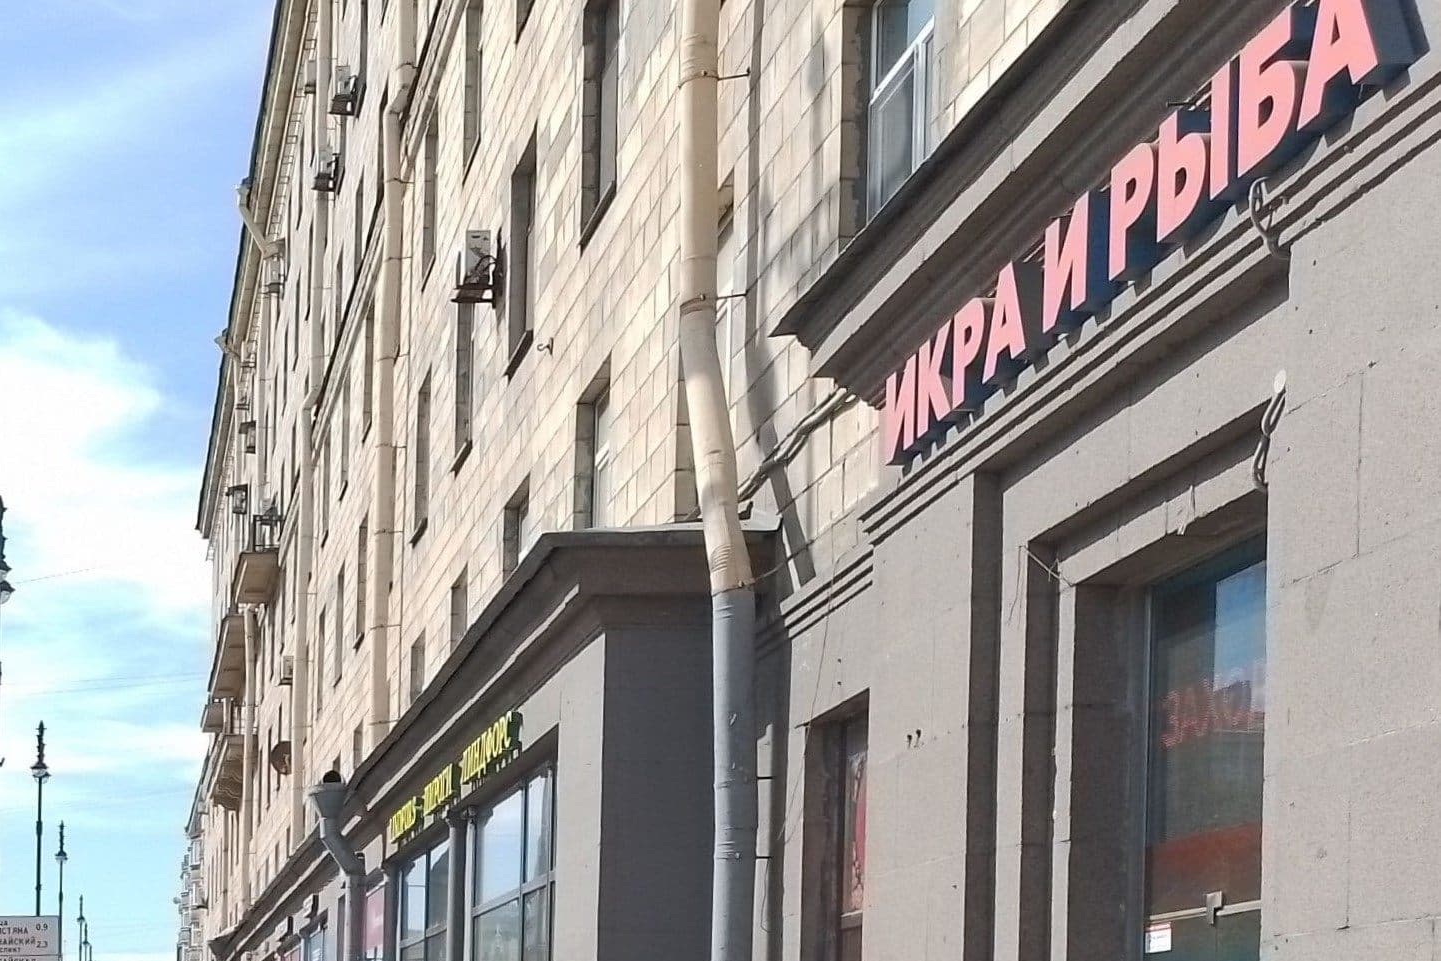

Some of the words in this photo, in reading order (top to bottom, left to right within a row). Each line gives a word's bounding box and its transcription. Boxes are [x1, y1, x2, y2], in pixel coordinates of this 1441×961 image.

[884, 261, 1026, 466] ИКРА
[1042, 194, 1090, 333] И
[1108, 0, 1379, 281] РЫБА
